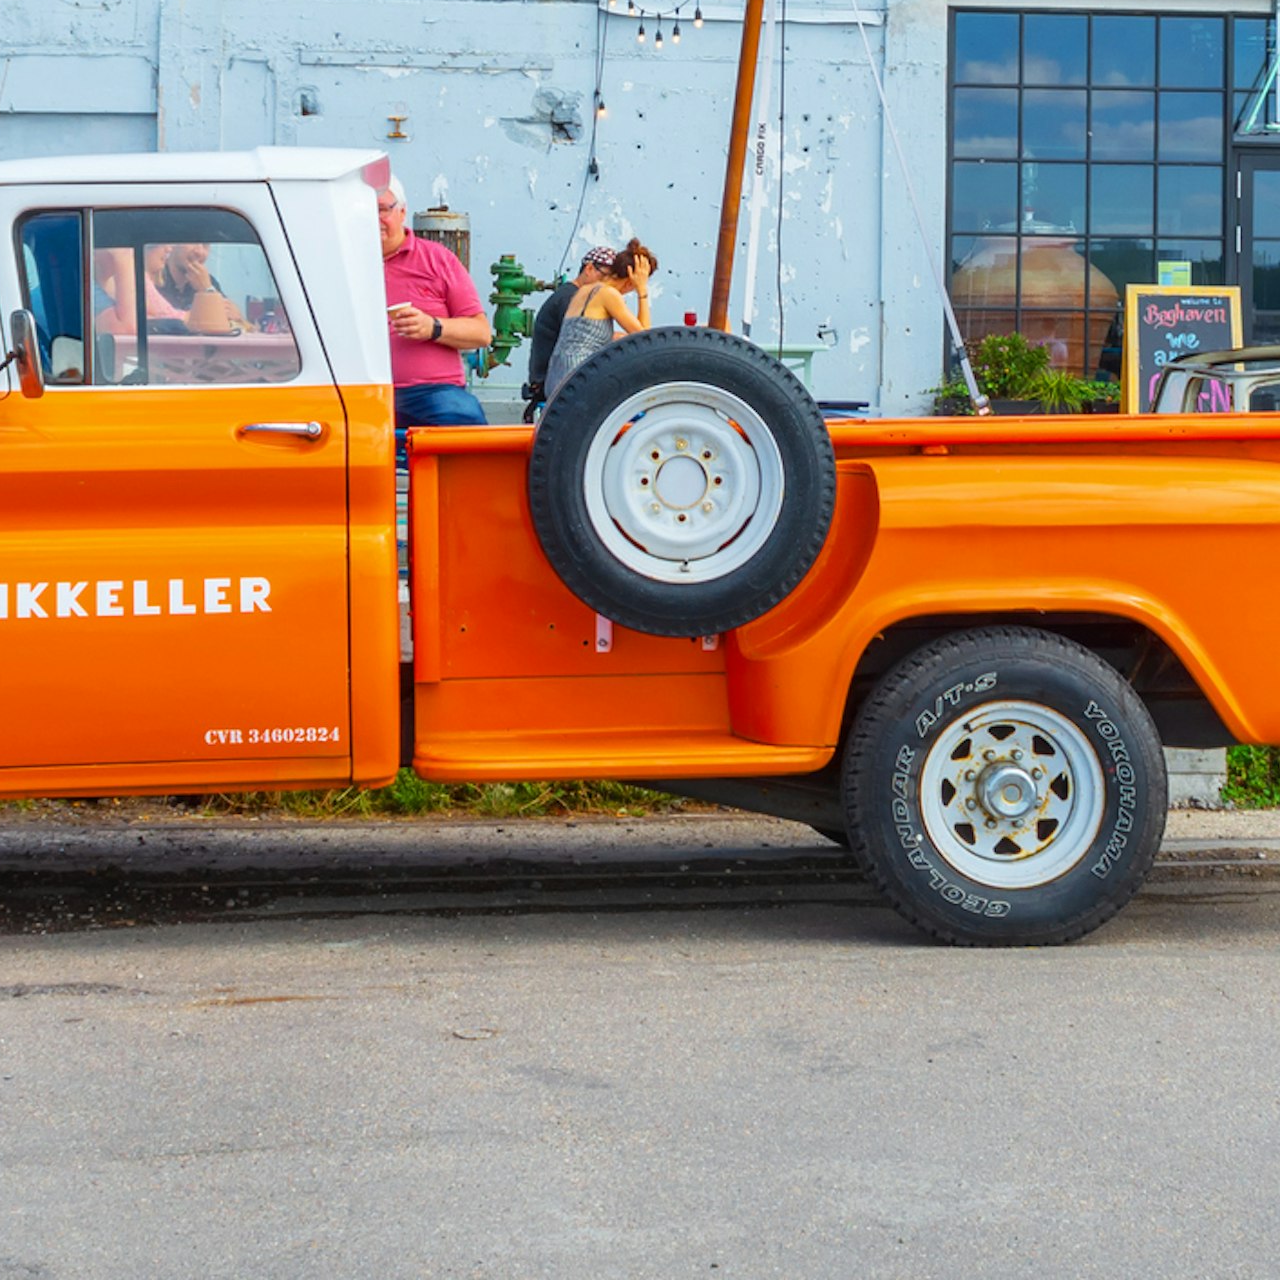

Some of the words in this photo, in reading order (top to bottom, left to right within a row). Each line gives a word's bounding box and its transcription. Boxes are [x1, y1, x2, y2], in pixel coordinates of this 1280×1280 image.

[757, 122, 767, 139] FIX
[755, 141, 765, 176] CARGO
[204, 729, 243, 745] CVR
[248, 726, 340, 743] 34602824
[1083, 701, 1136, 879] YOKOHAMA
[892, 745, 1011, 918] GEOLANDAR
